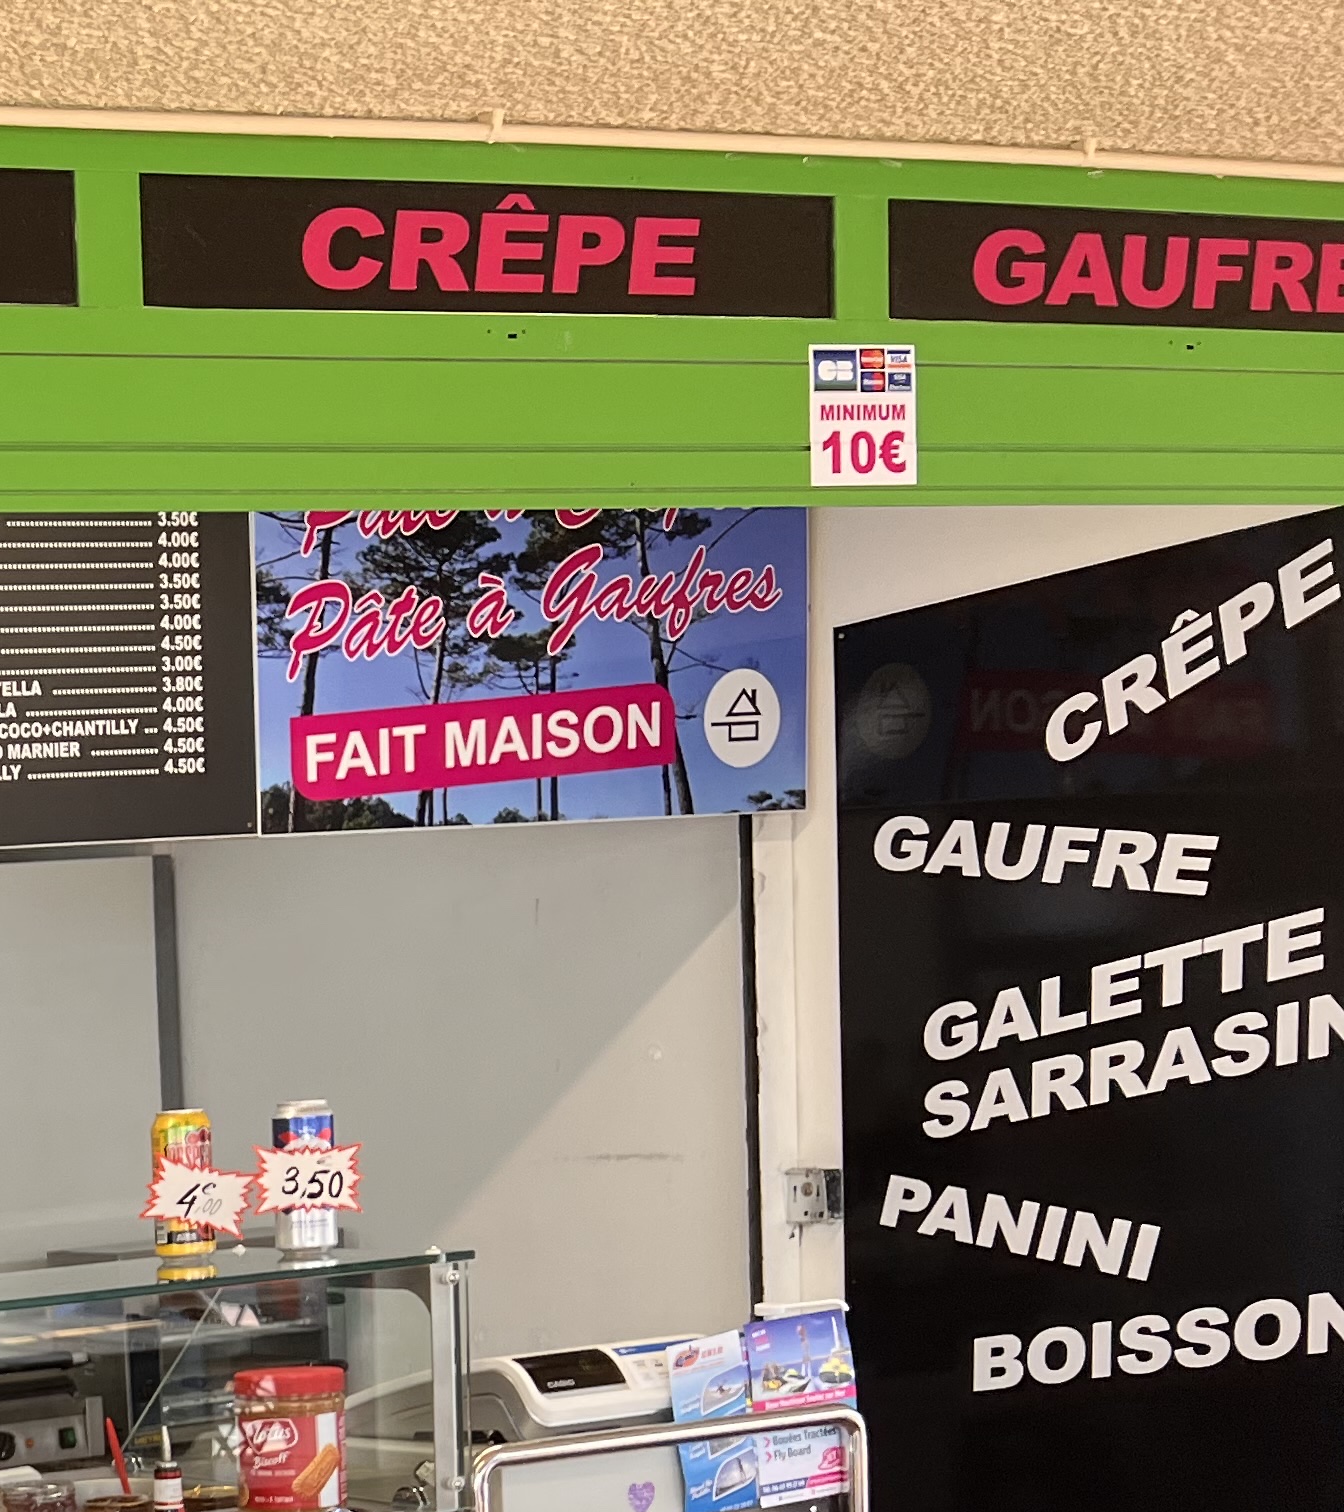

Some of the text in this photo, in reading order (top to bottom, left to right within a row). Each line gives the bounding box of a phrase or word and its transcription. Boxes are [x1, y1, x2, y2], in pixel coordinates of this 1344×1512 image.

[301, 193, 700, 295] CRÊPE
[820, 404, 905, 420] MINIMUM
[822, 431, 906, 474] 10€
[158, 532, 199, 547] 4.00€
[158, 552, 199, 568] 4.00€
[160, 573, 200, 588] 3.50€
[286, 543, 782, 682] Pâte à Gaufres
[1046, 538, 1341, 762] CRÊPE
[8, 742, 80, 759] MARNIER
[164, 737, 204, 753] 4.50€
[164, 757, 205, 774] 4.50€
[306, 701, 661, 782] FAIT MAISON
[873, 816, 1219, 896] GAUFRE
[923, 907, 1324, 1061] GALETTE
[879, 1174, 1160, 1282] PANINI
